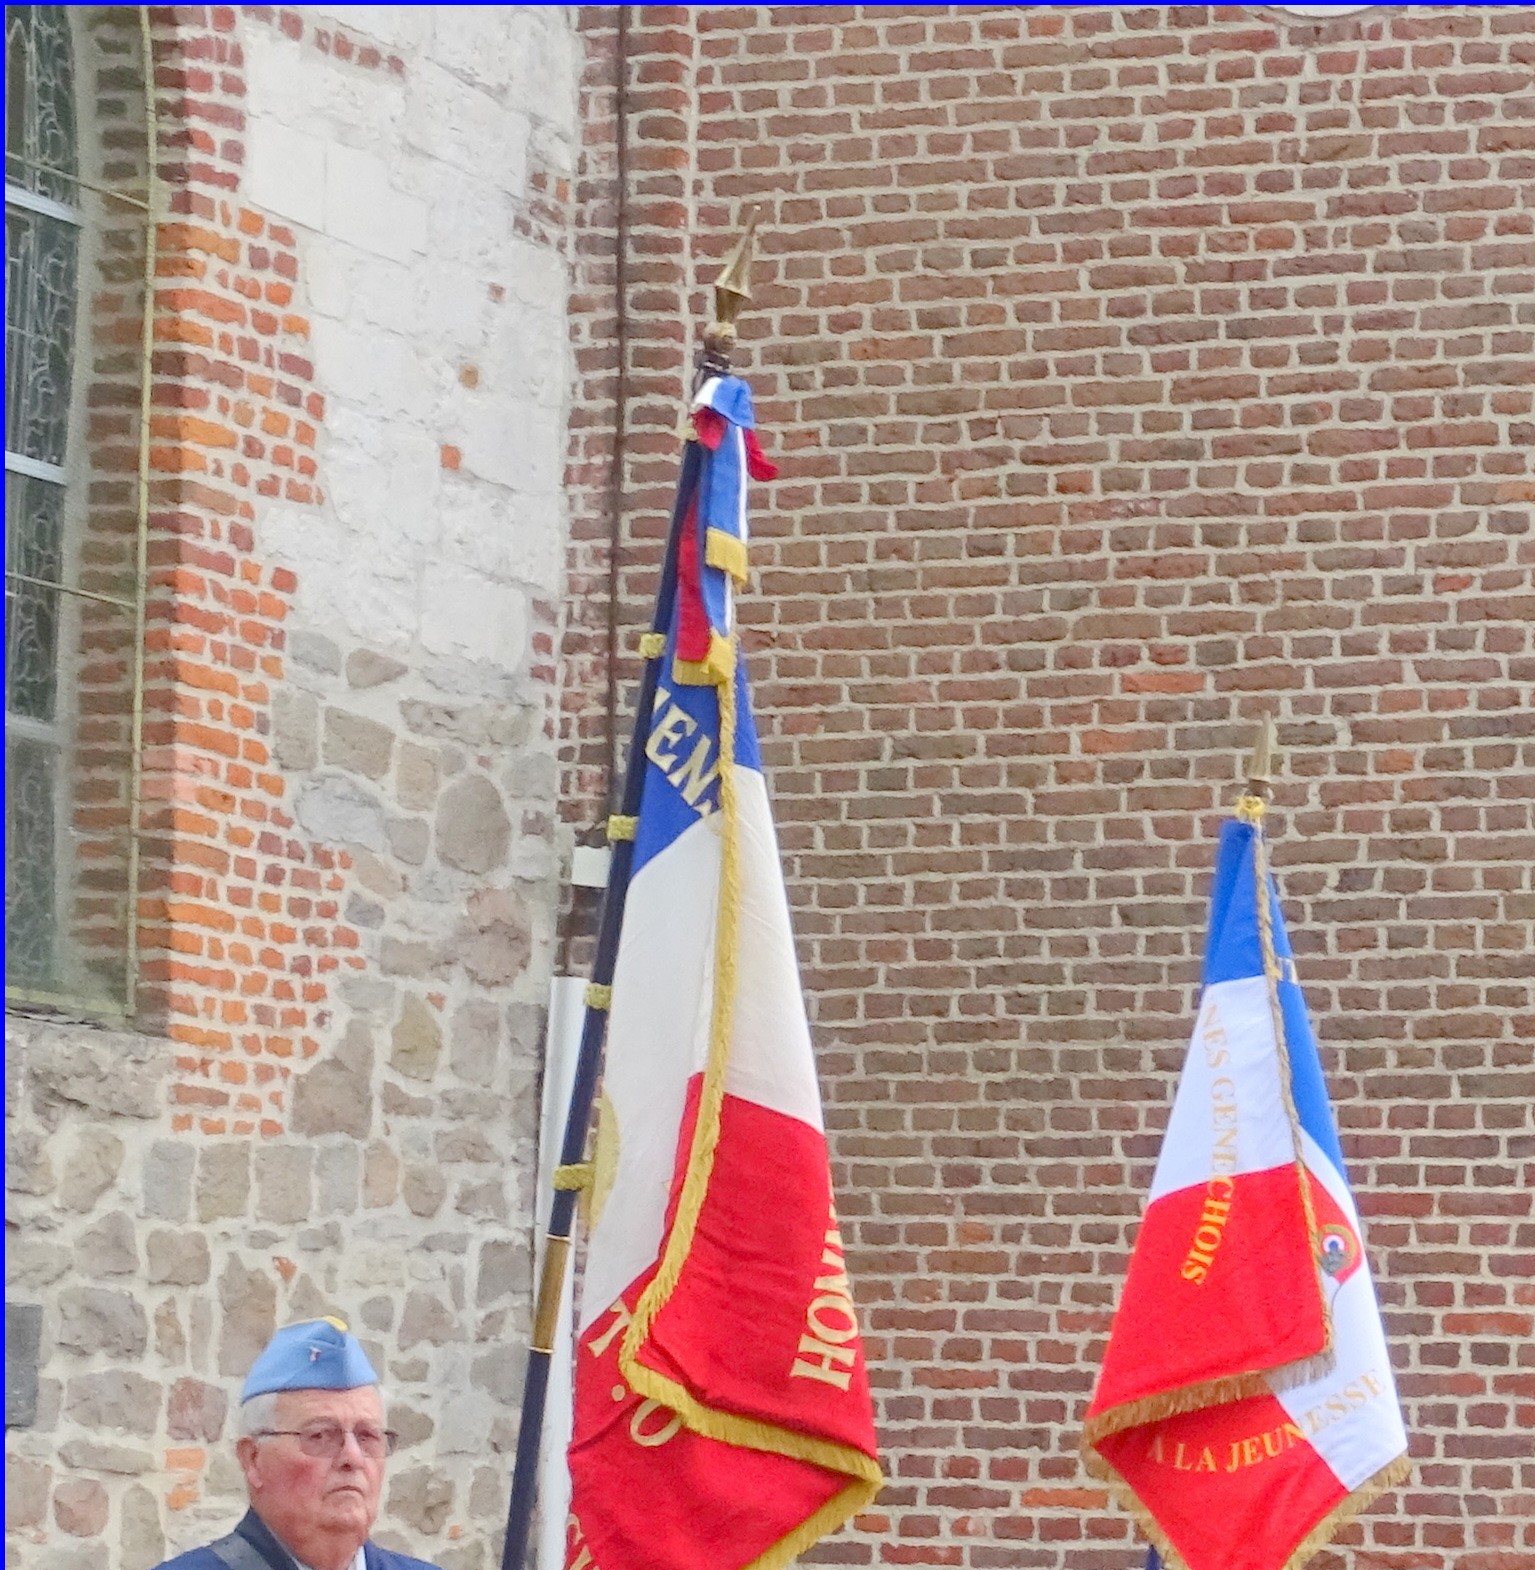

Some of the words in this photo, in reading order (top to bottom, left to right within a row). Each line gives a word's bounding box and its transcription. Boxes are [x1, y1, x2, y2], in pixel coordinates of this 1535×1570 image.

[1180, 1077, 1238, 1286] GENECHOIS
[1173, 1443, 1217, 1473] LA
[1225, 1370, 1387, 1473] JEUNESSE
